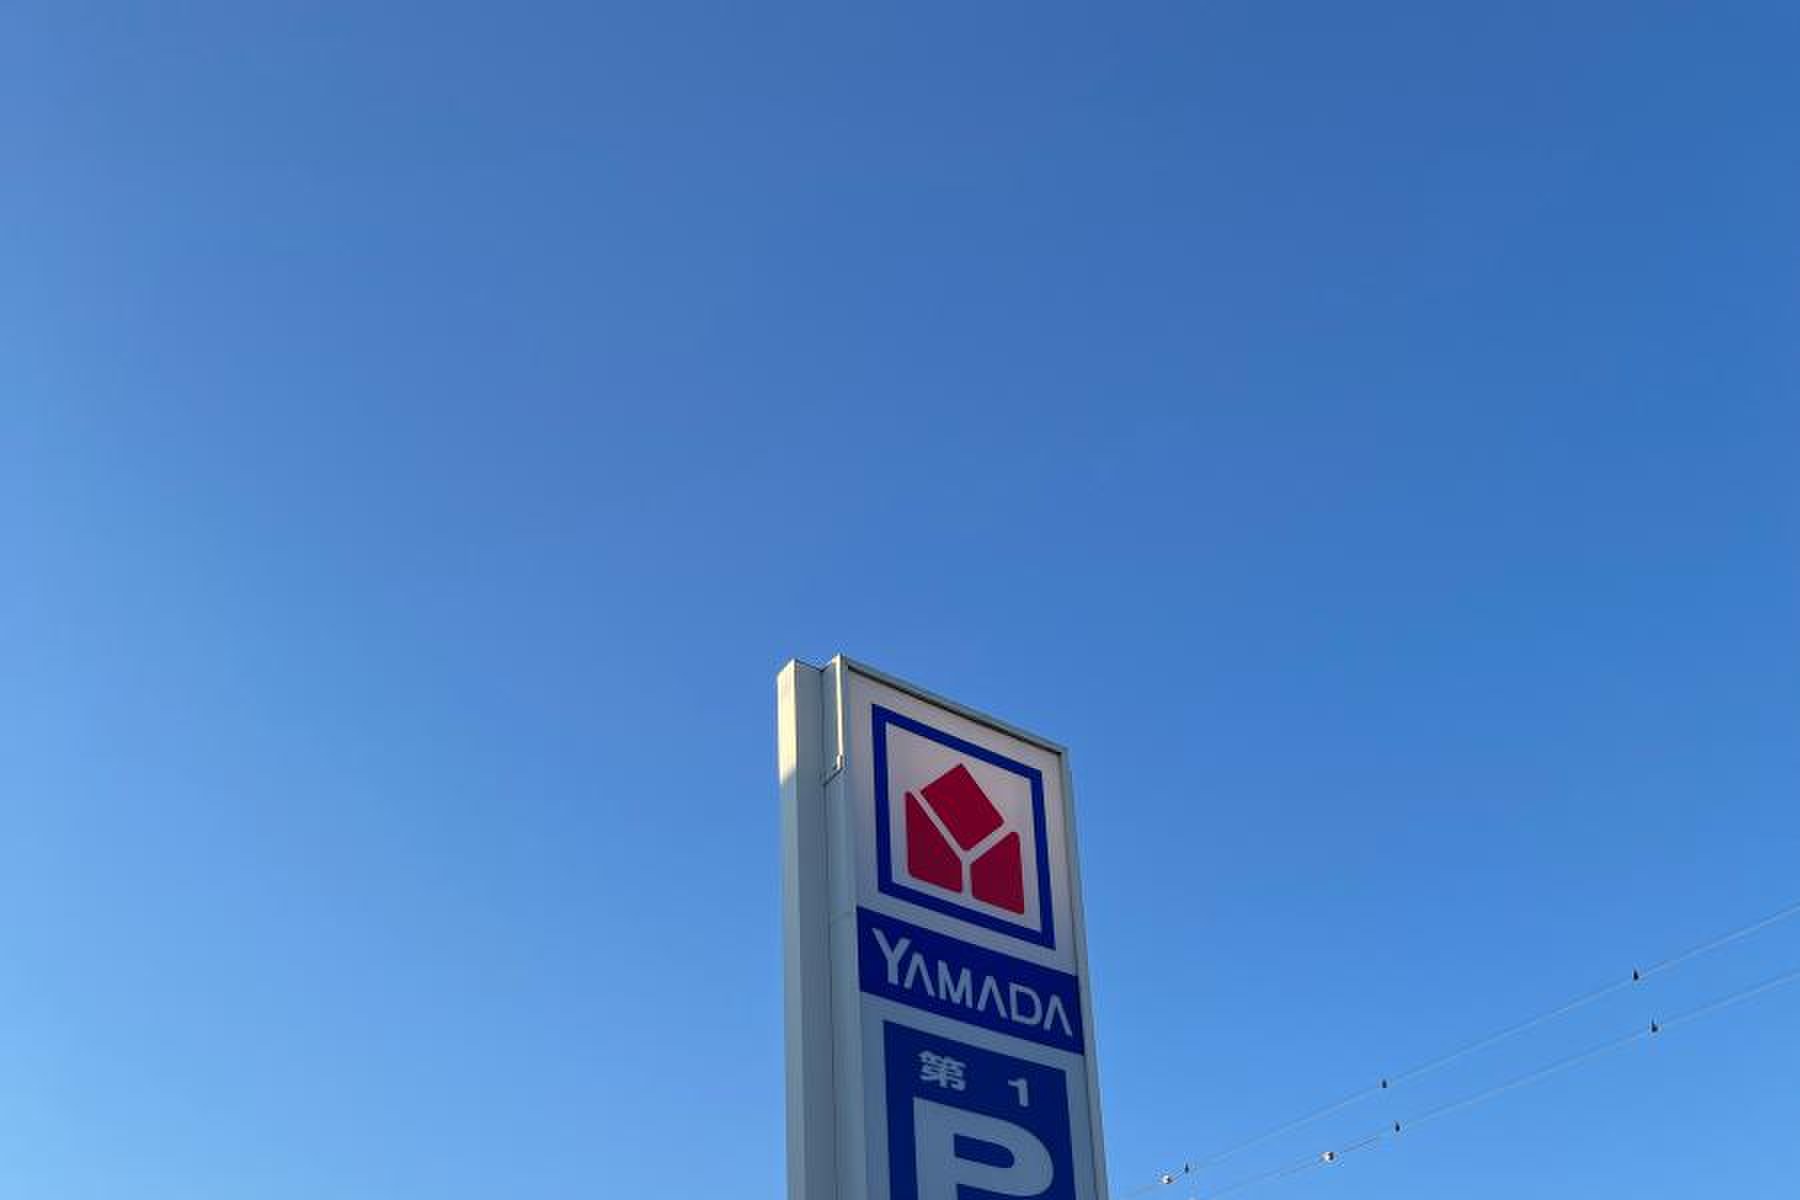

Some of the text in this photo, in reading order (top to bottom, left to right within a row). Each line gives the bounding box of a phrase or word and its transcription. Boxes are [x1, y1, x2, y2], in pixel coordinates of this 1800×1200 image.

[871, 927, 1074, 1038] YAMADA
[918, 1050, 1030, 1108] 第 1
